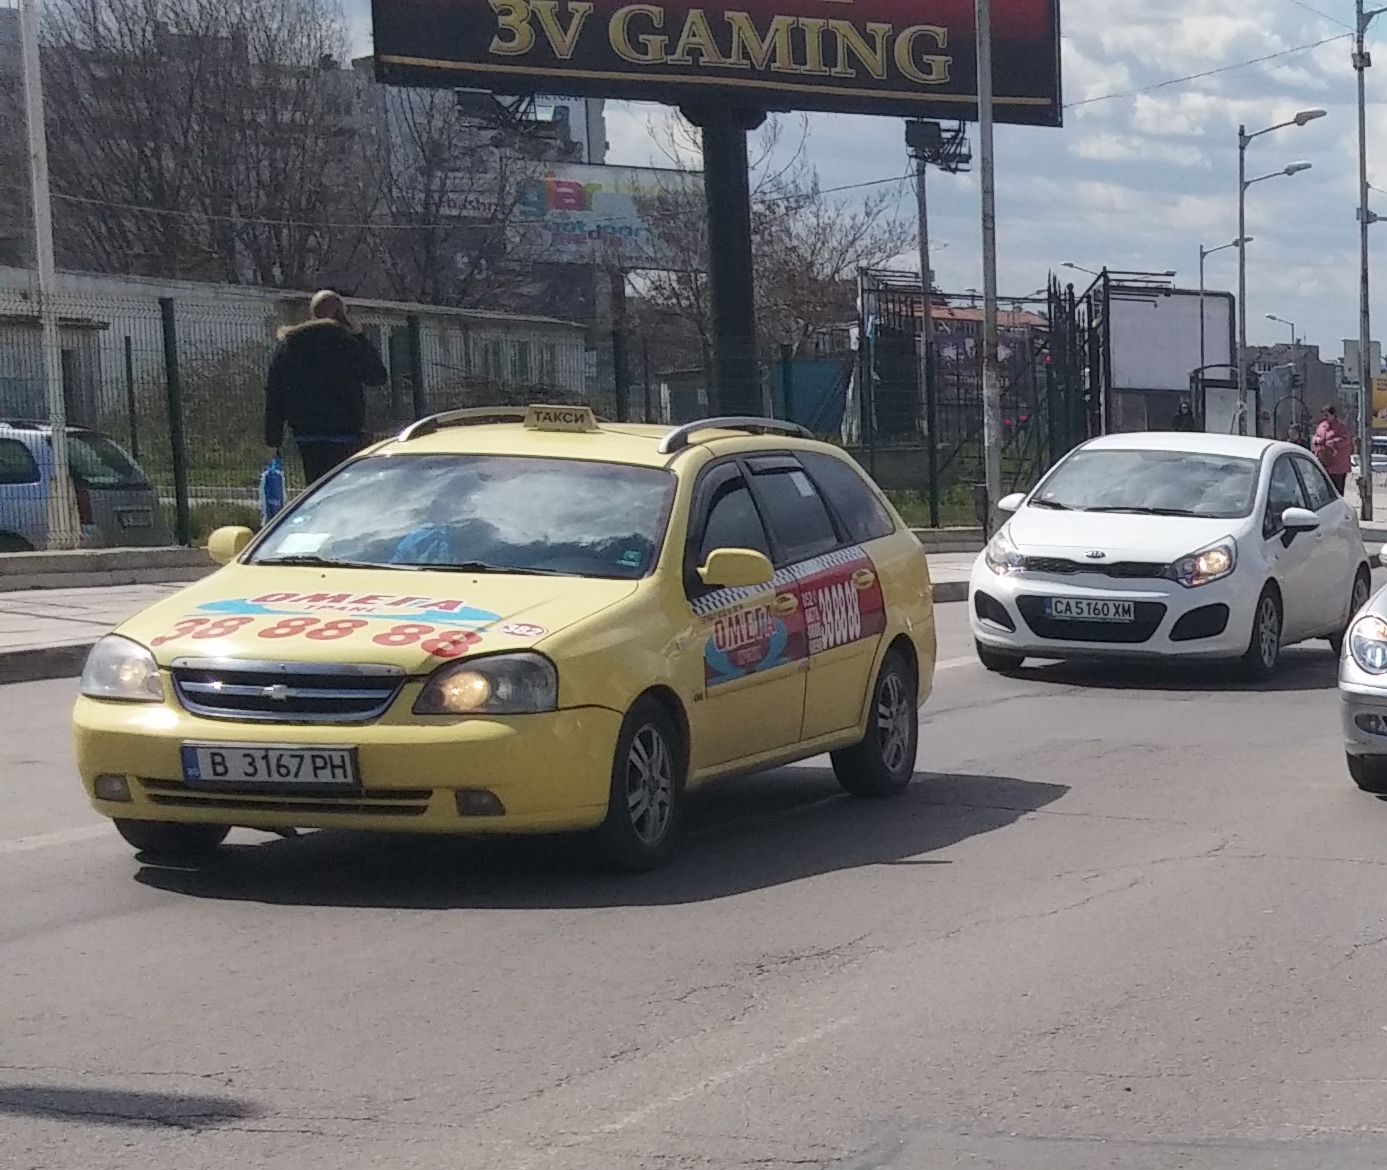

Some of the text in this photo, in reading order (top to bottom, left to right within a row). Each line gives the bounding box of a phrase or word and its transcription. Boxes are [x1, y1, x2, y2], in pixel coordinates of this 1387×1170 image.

[489, 0, 952, 84] 3V GAMING
[534, 411, 585, 424] ТАКСИ
[250, 592, 465, 612] ОМЕГА
[1054, 600, 1131, 618] CA 5160 XM
[150, 617, 483, 658] 38 88 88
[713, 604, 778, 652] ОМЕГА
[210, 751, 348, 779] B 3167 PH
